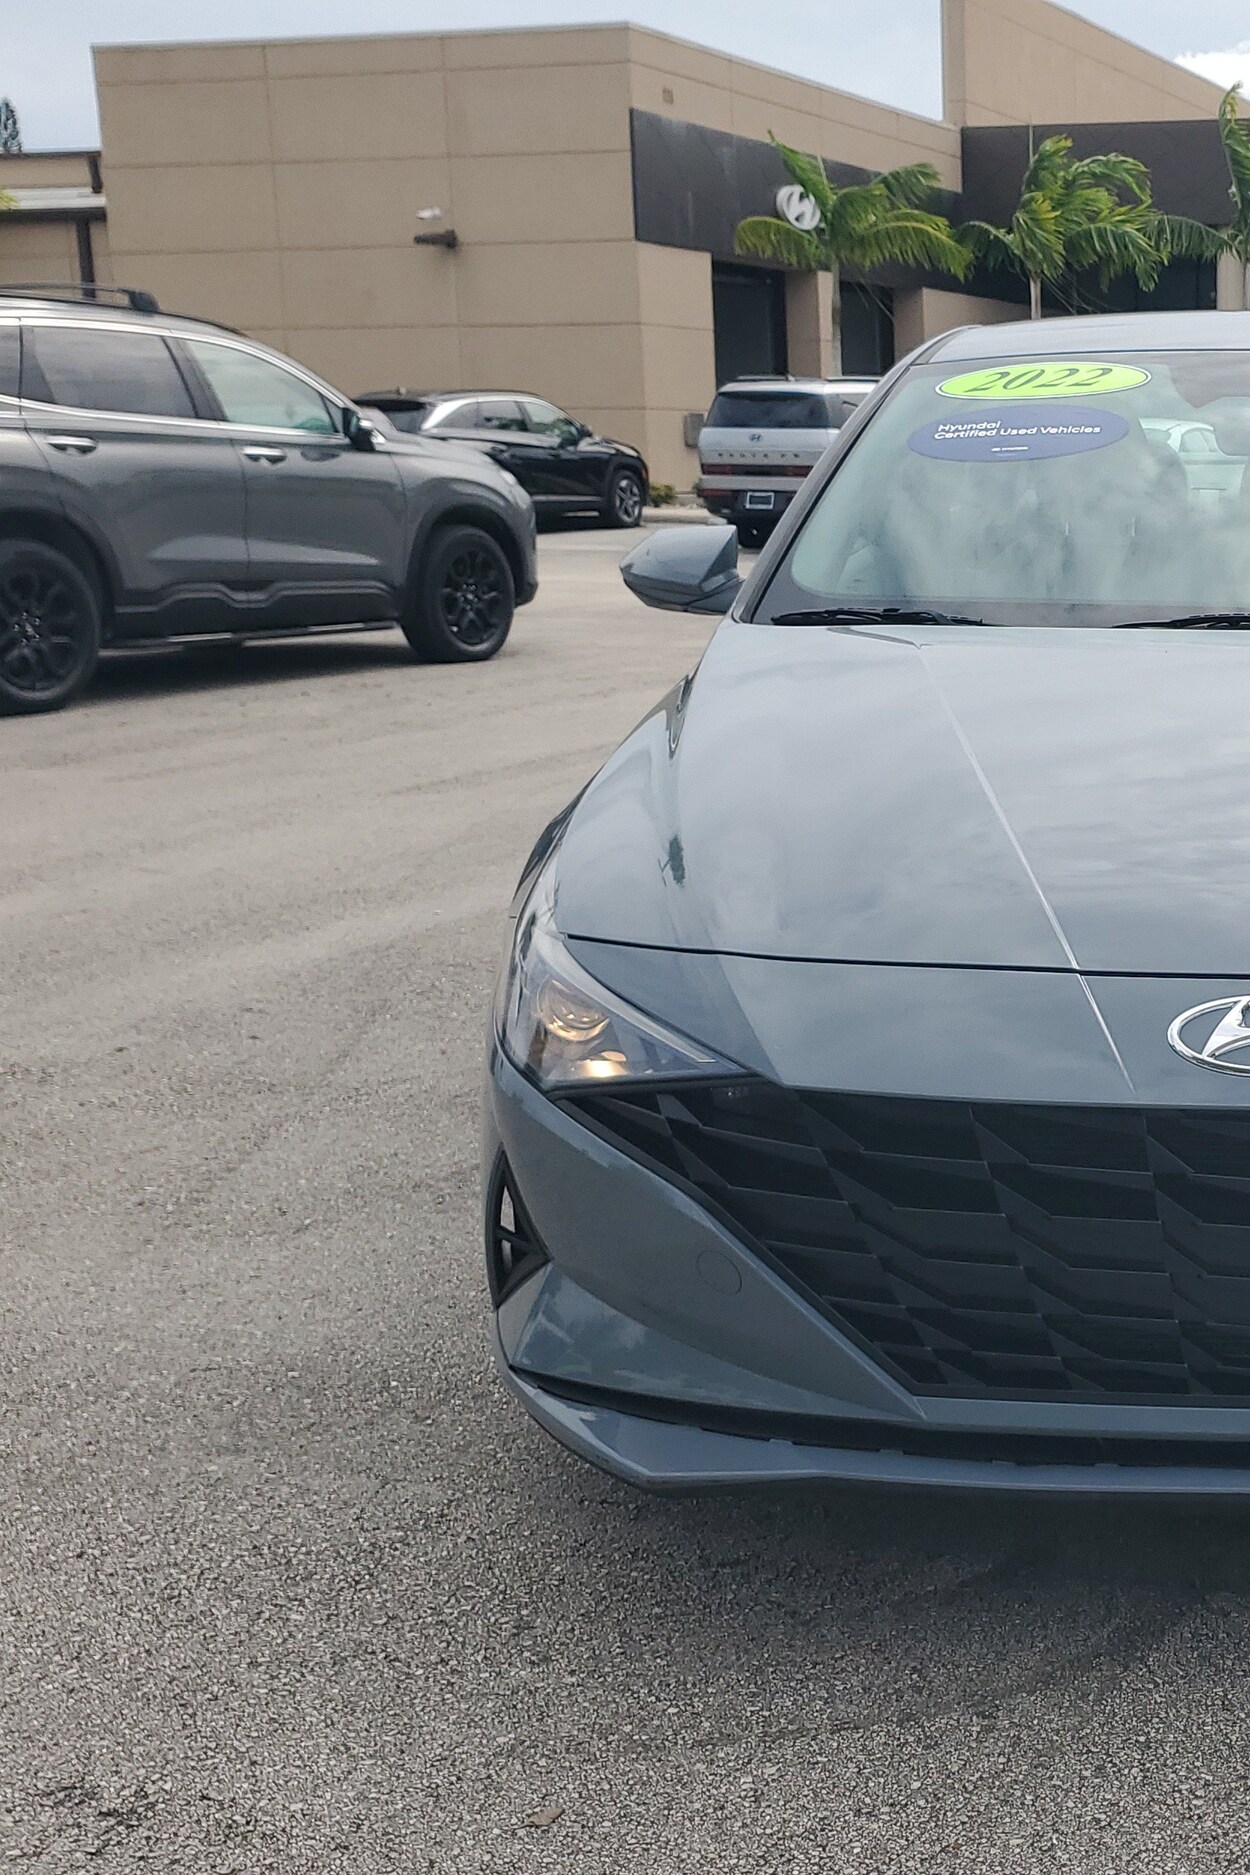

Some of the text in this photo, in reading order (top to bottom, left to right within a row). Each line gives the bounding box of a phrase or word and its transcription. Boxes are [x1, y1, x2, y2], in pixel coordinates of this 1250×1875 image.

[964, 367, 1113, 393] 2022
[934, 425, 1101, 440] Certified Used Vehicles
[938, 420, 1001, 433] Hyundai
